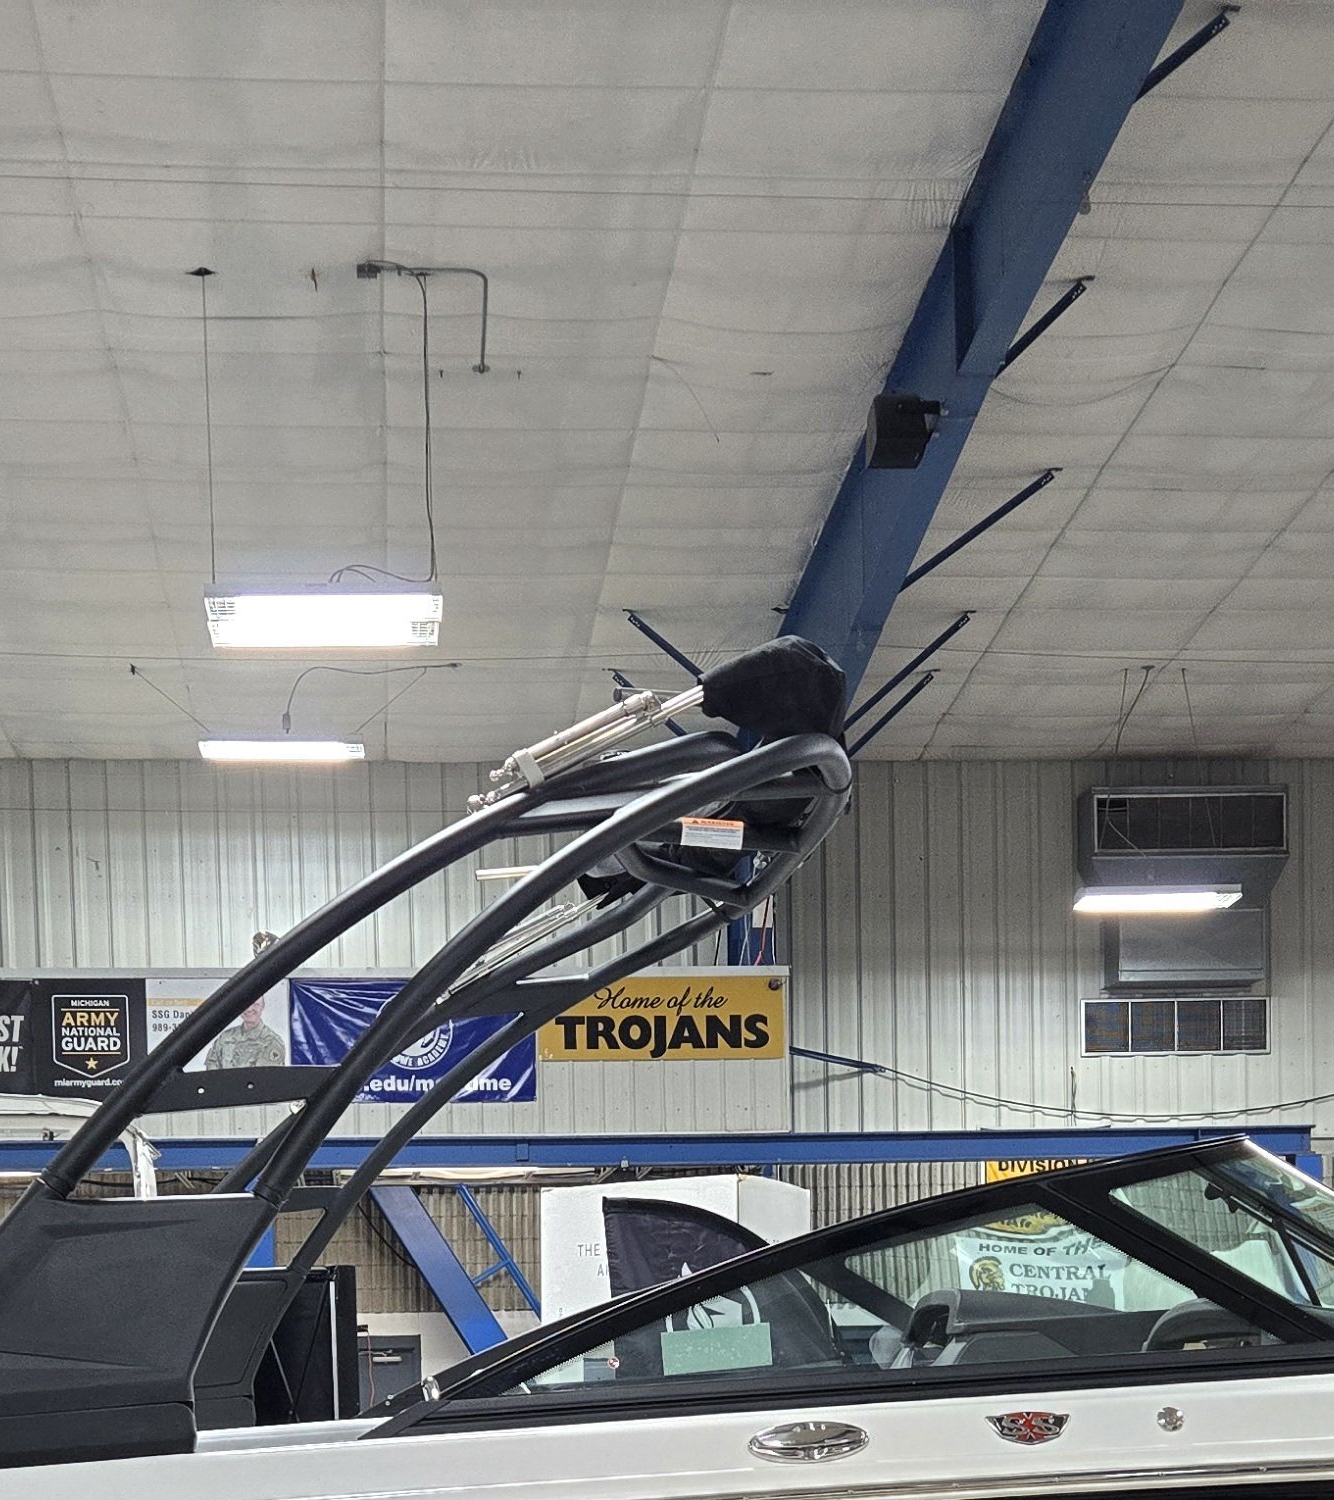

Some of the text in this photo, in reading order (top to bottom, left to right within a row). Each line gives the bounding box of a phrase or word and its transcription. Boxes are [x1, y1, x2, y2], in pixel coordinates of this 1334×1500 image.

[594, 986, 728, 1016] Home of the
[62, 1012, 119, 1026] ARMY
[151, 1010, 170, 1019] SSG
[61, 1027, 121, 1036] NATIONAL
[555, 1013, 770, 1059] TROJANS
[61, 1037, 121, 1051] GUARD
[54, 1078, 123, 1088] miarmyguard.co
[577, 1244, 600, 1257] THE
[978, 1238, 1101, 1256] HOME OF THE
[1009, 1263, 1112, 1281] CENTRAL
[1011, 1283, 1088, 1301] TROJA
